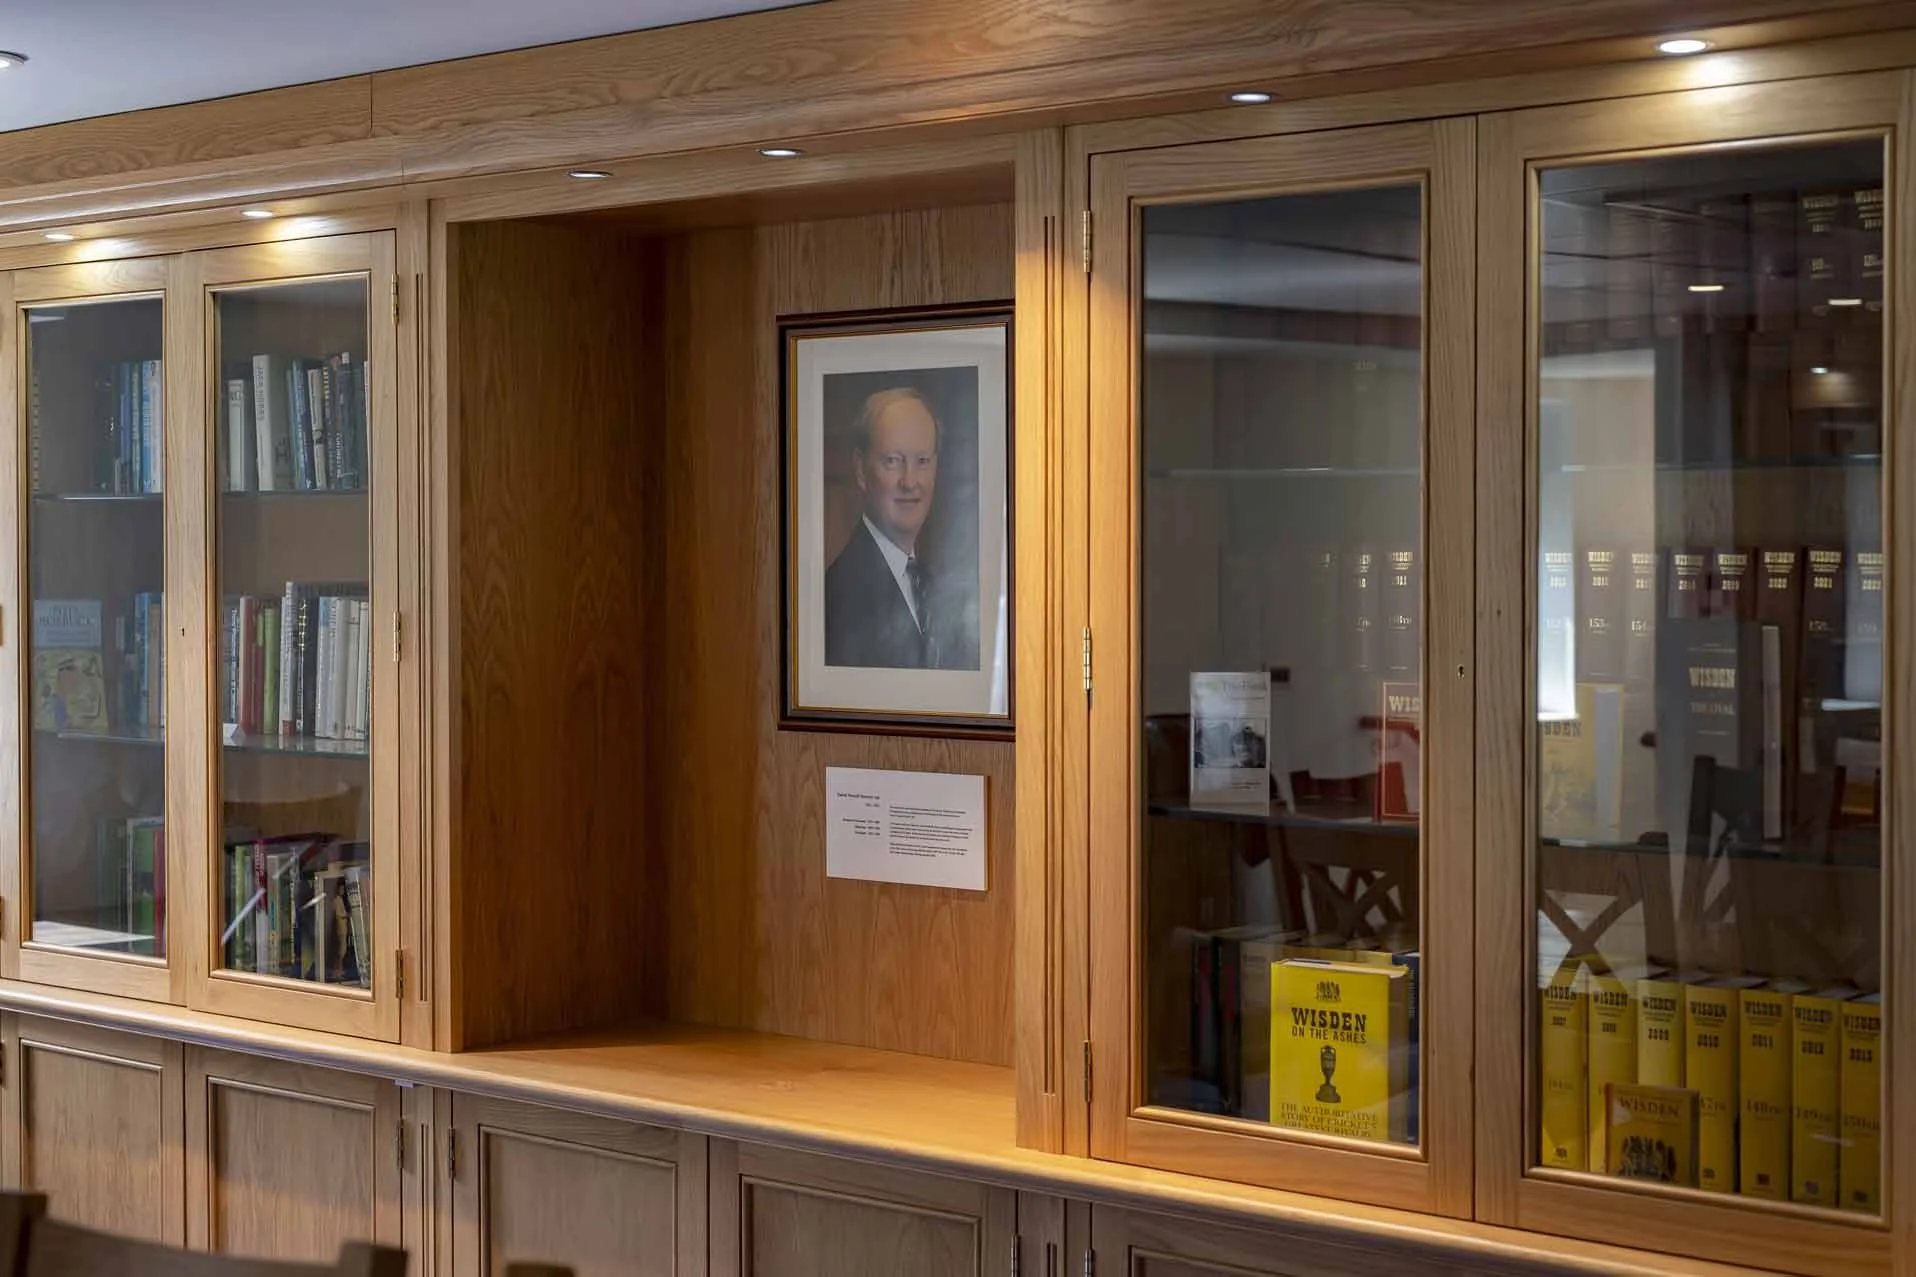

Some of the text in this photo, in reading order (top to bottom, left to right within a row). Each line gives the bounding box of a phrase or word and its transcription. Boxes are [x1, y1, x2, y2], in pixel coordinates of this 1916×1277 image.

[1689, 668, 1736, 688] WISDEN
[1594, 990, 1628, 1007] WISDEN
[1690, 1001, 1727, 1018] WISDEN
[1745, 1001, 1782, 1018] WISDEN
[1795, 1007, 1833, 1024] WISDEN
[1291, 1007, 1367, 1032] WISDEN
[1292, 1026, 1367, 1044] ON THE ASHES
[1281, 1103, 1378, 1120] THE AUTHORITATIVE
[1616, 1095, 1681, 1117] WISDEN
[1312, 1115, 1325, 1124] OF
